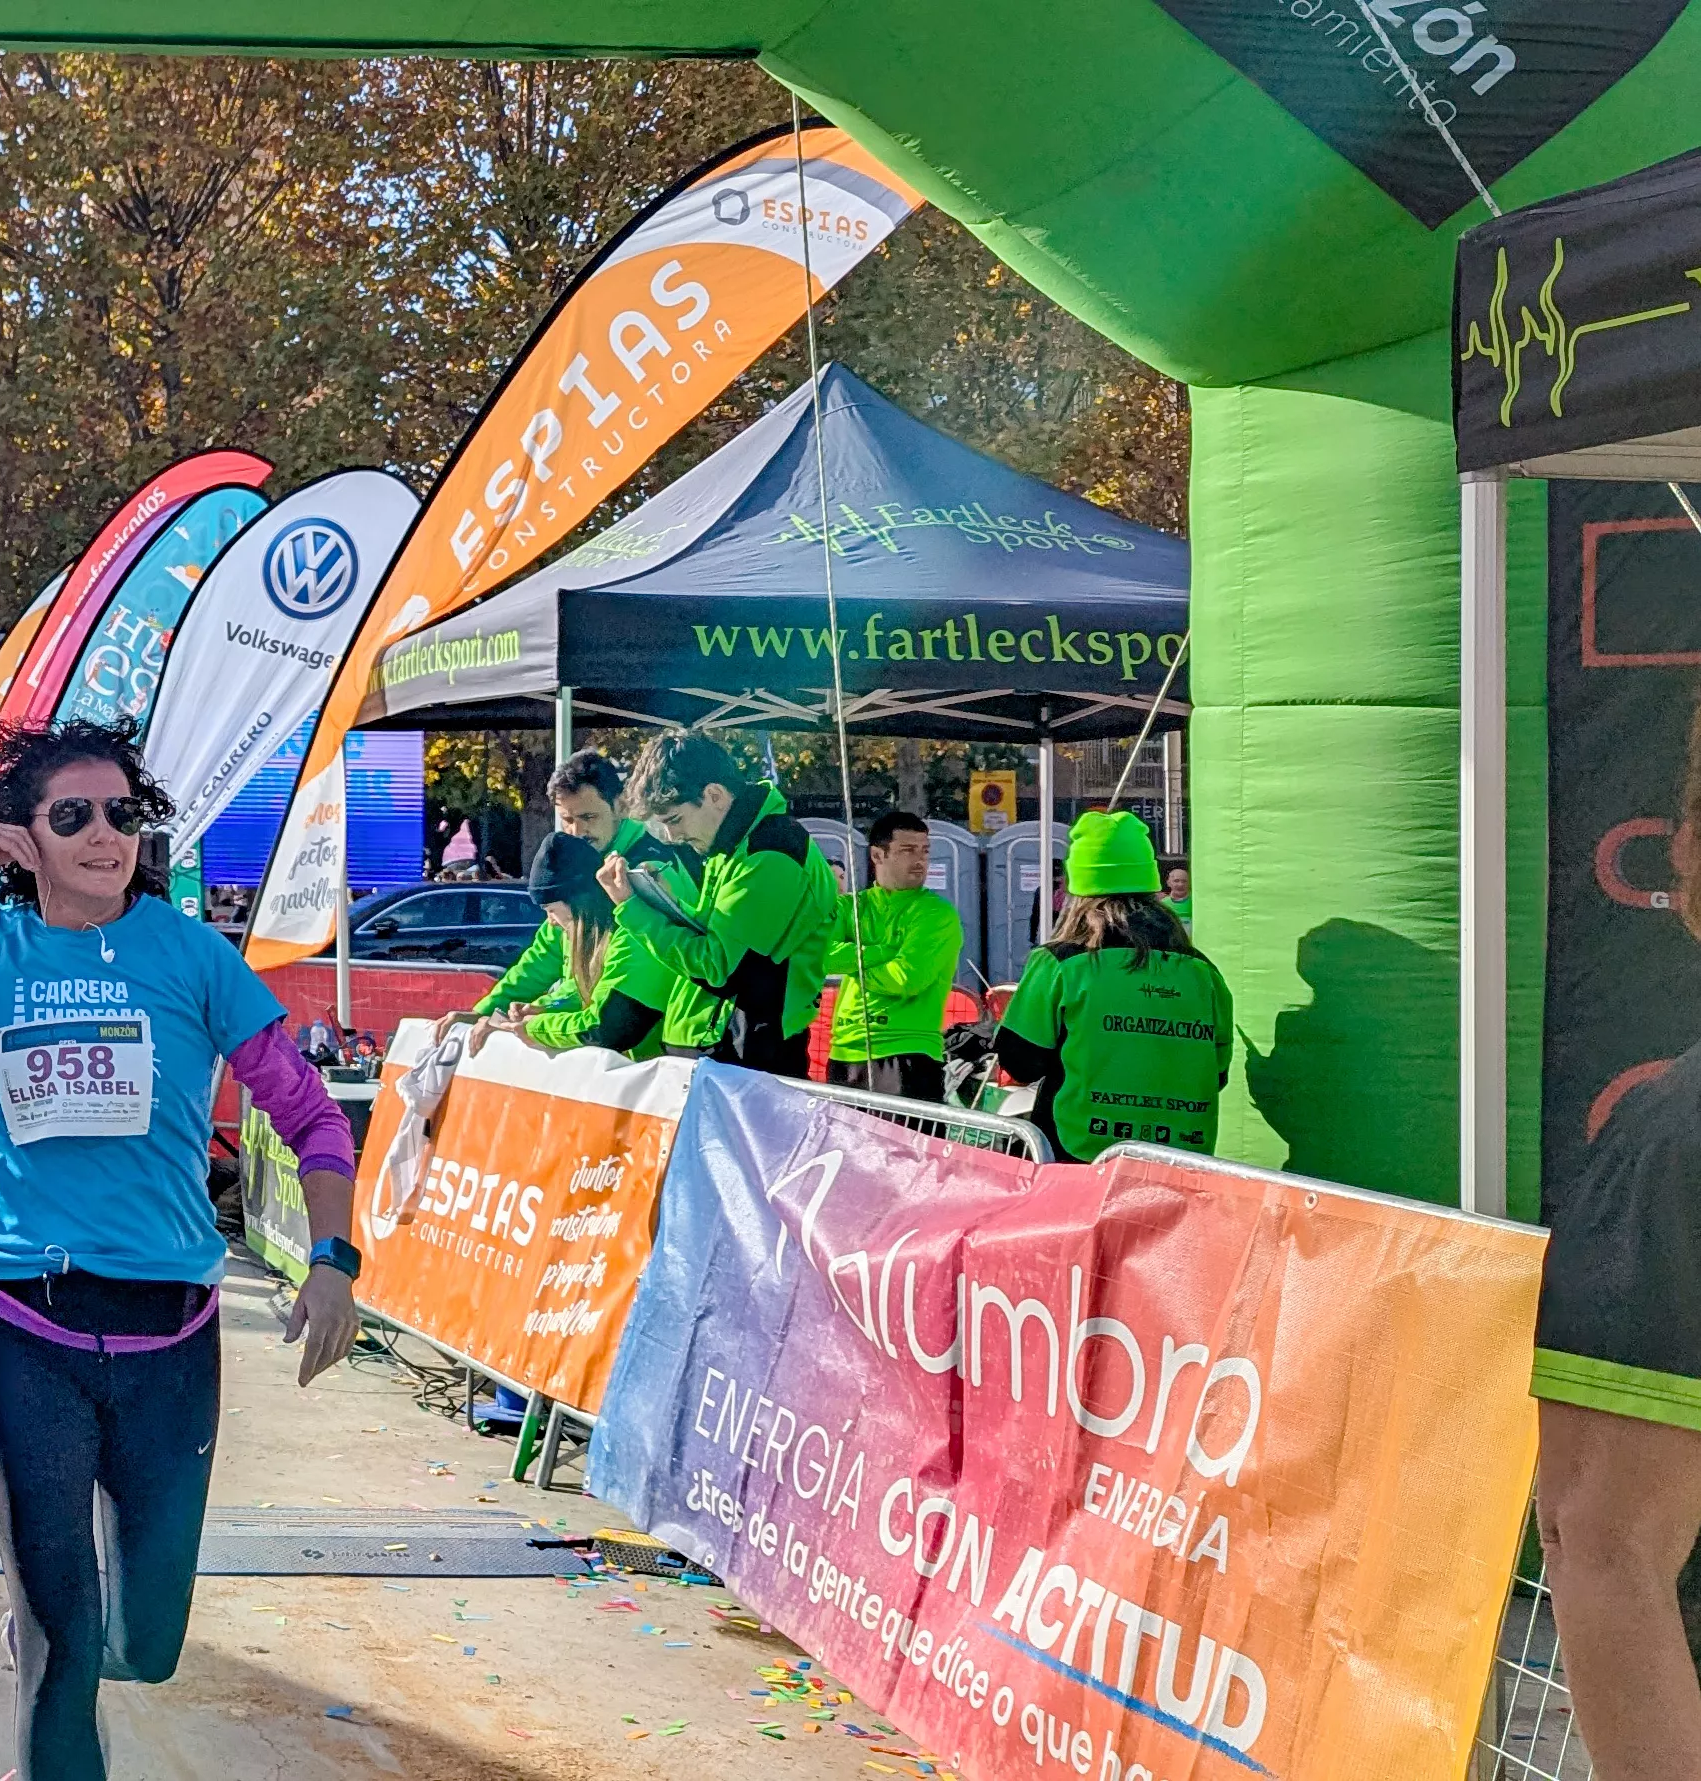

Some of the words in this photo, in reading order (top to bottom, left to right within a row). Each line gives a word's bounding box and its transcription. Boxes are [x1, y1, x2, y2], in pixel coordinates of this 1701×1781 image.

[1279, 0, 1457, 127] amiento
[762, 198, 869, 241] ESPIAS
[448, 257, 711, 572] ESPIAS
[459, 318, 733, 592] CONSTRUCTORA
[870, 501, 1074, 538] Fartleck
[225, 620, 337, 671] Volkswage
[201, 710, 274, 800] CABRERO
[30, 978, 129, 1005] CARRERA
[1102, 1015, 1215, 1042] ORGANIZACIÓN
[9, 1082, 60, 1104] ELISA
[65, 1080, 141, 1096] ISABEL
[26, 1045, 116, 1084] 958
[418, 1155, 545, 1247] ESPIAS
[693, 1365, 866, 1531] ENERGÍA
[877, 1475, 997, 1608] CON
[991, 1546, 1271, 1755] ACTITUD
[1083, 1461, 1231, 1574] ENERGÍA
[747, 1512, 779, 1558] de
[783, 1521, 807, 1575] la
[808, 1560, 882, 1632] gente
[879, 1613, 934, 1668] que
[931, 1635, 991, 1706] dice
[990, 1685, 1014, 1727] o
[1019, 1702, 1095, 1768] que
[1099, 1729, 1171, 1781] ha
